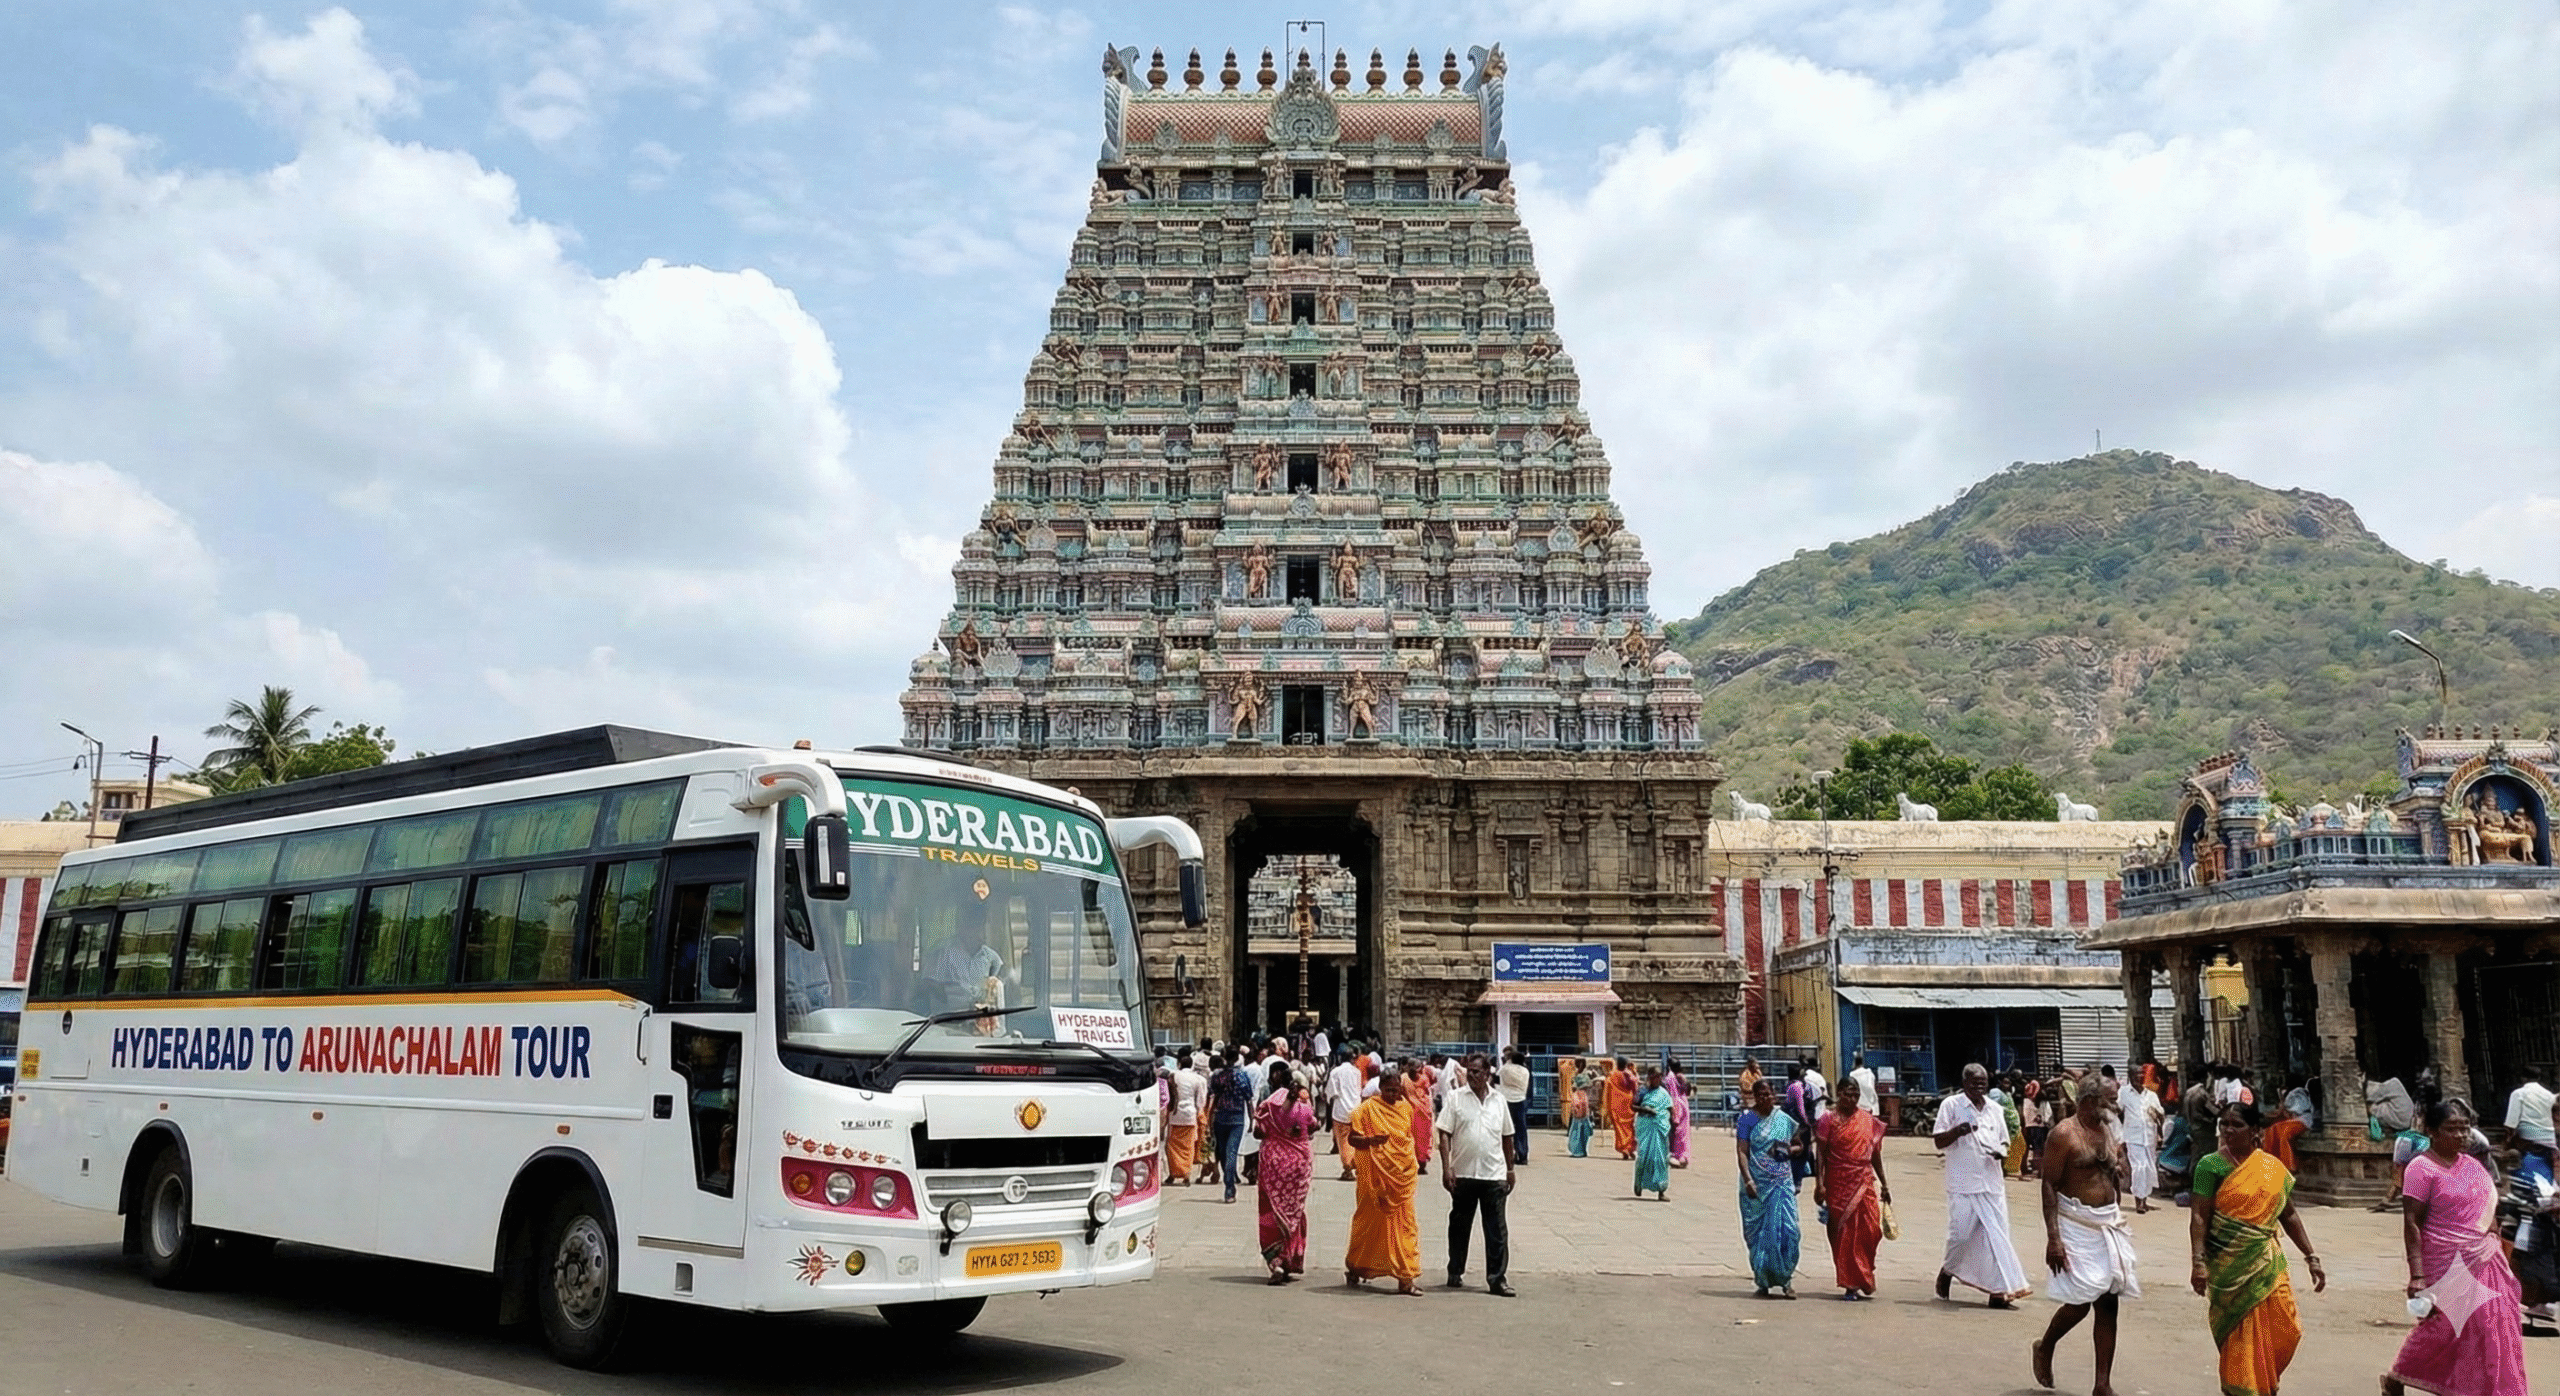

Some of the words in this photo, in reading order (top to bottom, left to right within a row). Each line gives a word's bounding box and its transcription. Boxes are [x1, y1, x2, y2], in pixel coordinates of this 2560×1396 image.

[846, 791, 1103, 865] YDERABAD
[922, 847, 1039, 872] TRAVELS
[1058, 1014, 1127, 1028] HYDERABAD
[1074, 1029, 1126, 1043] TRAVELS
[112, 1027, 254, 1070] HYDERABAD
[262, 1027, 293, 1072] TO
[299, 1026, 502, 1076] ARUNACHALAM
[511, 1026, 590, 1078] TOUR
